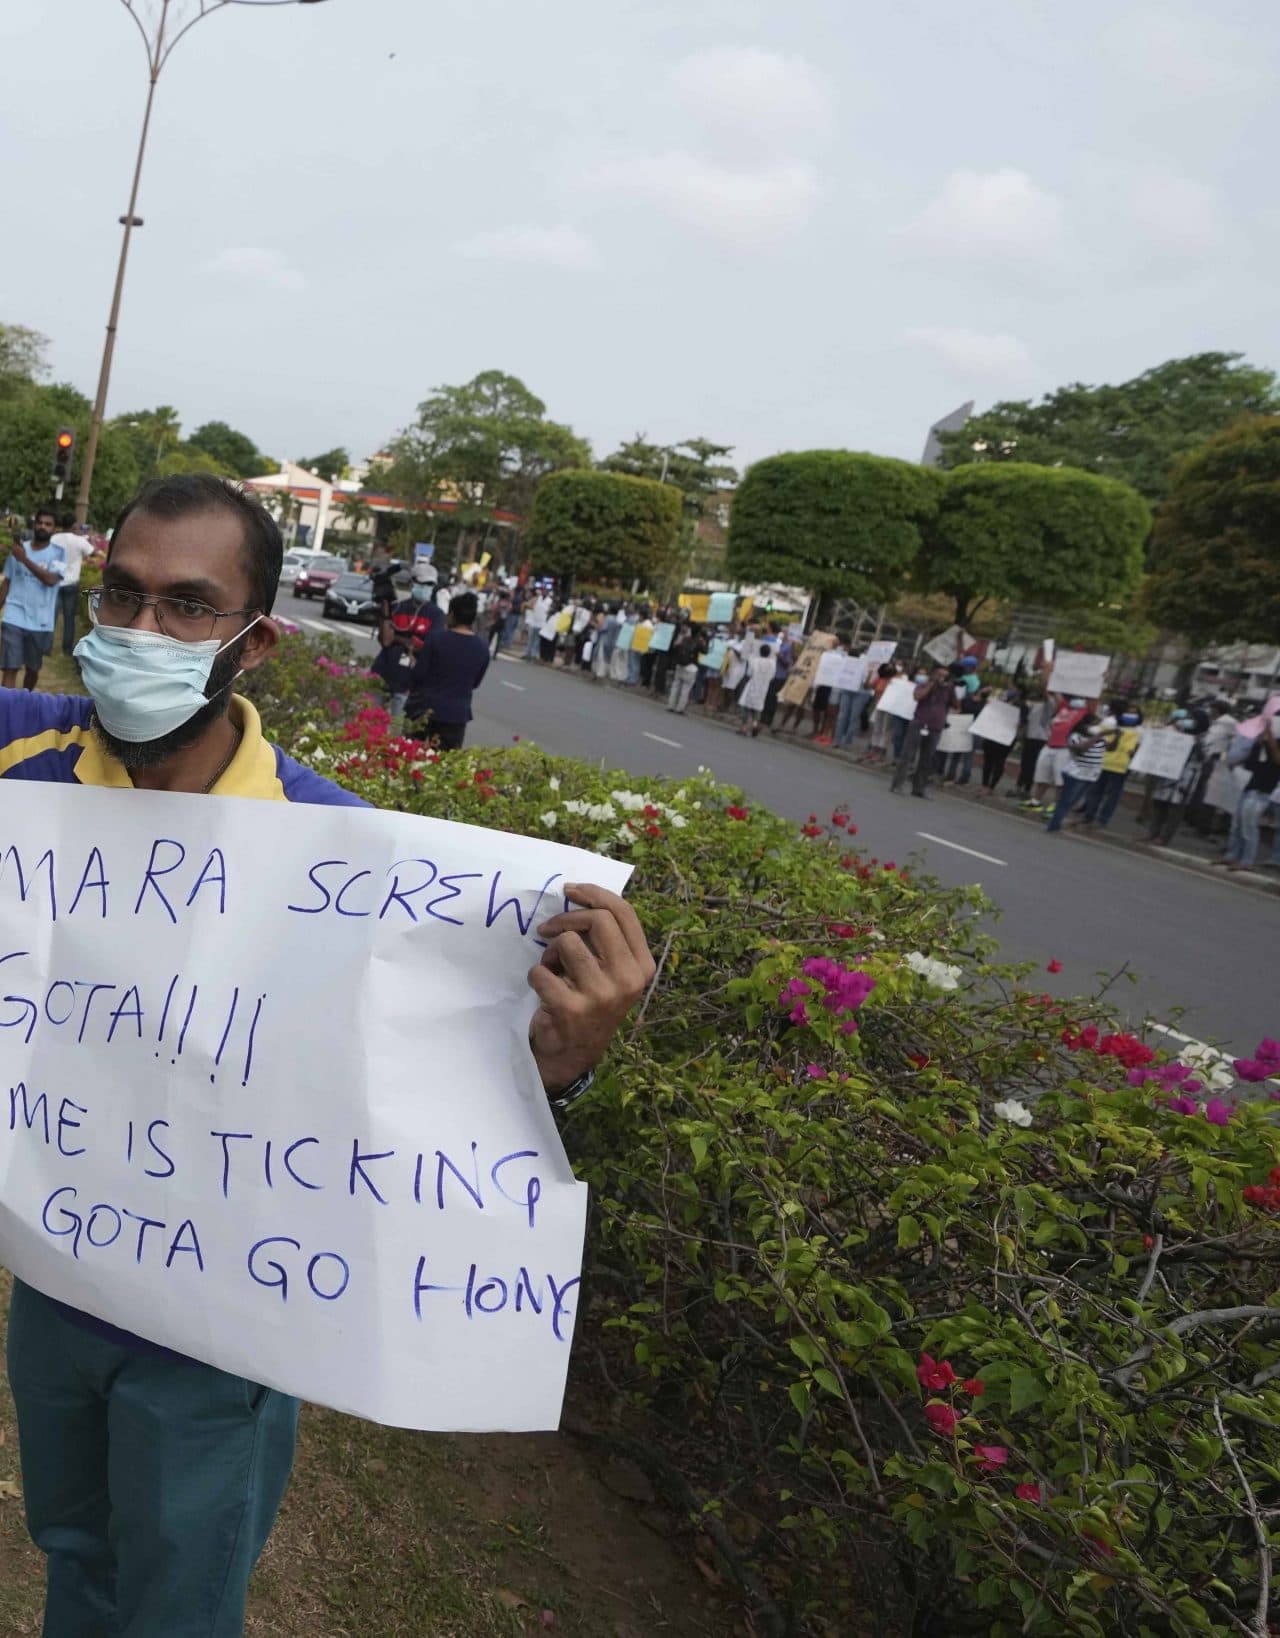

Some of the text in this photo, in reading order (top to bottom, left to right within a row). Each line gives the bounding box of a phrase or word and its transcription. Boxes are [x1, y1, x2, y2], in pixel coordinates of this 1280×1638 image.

[287, 858, 571, 948] SCREW
[127, 1119, 176, 1179] IS
[210, 1131, 541, 1229] TICKING
[41, 1185, 205, 1273] GOTA
[247, 1236, 351, 1304] GO
